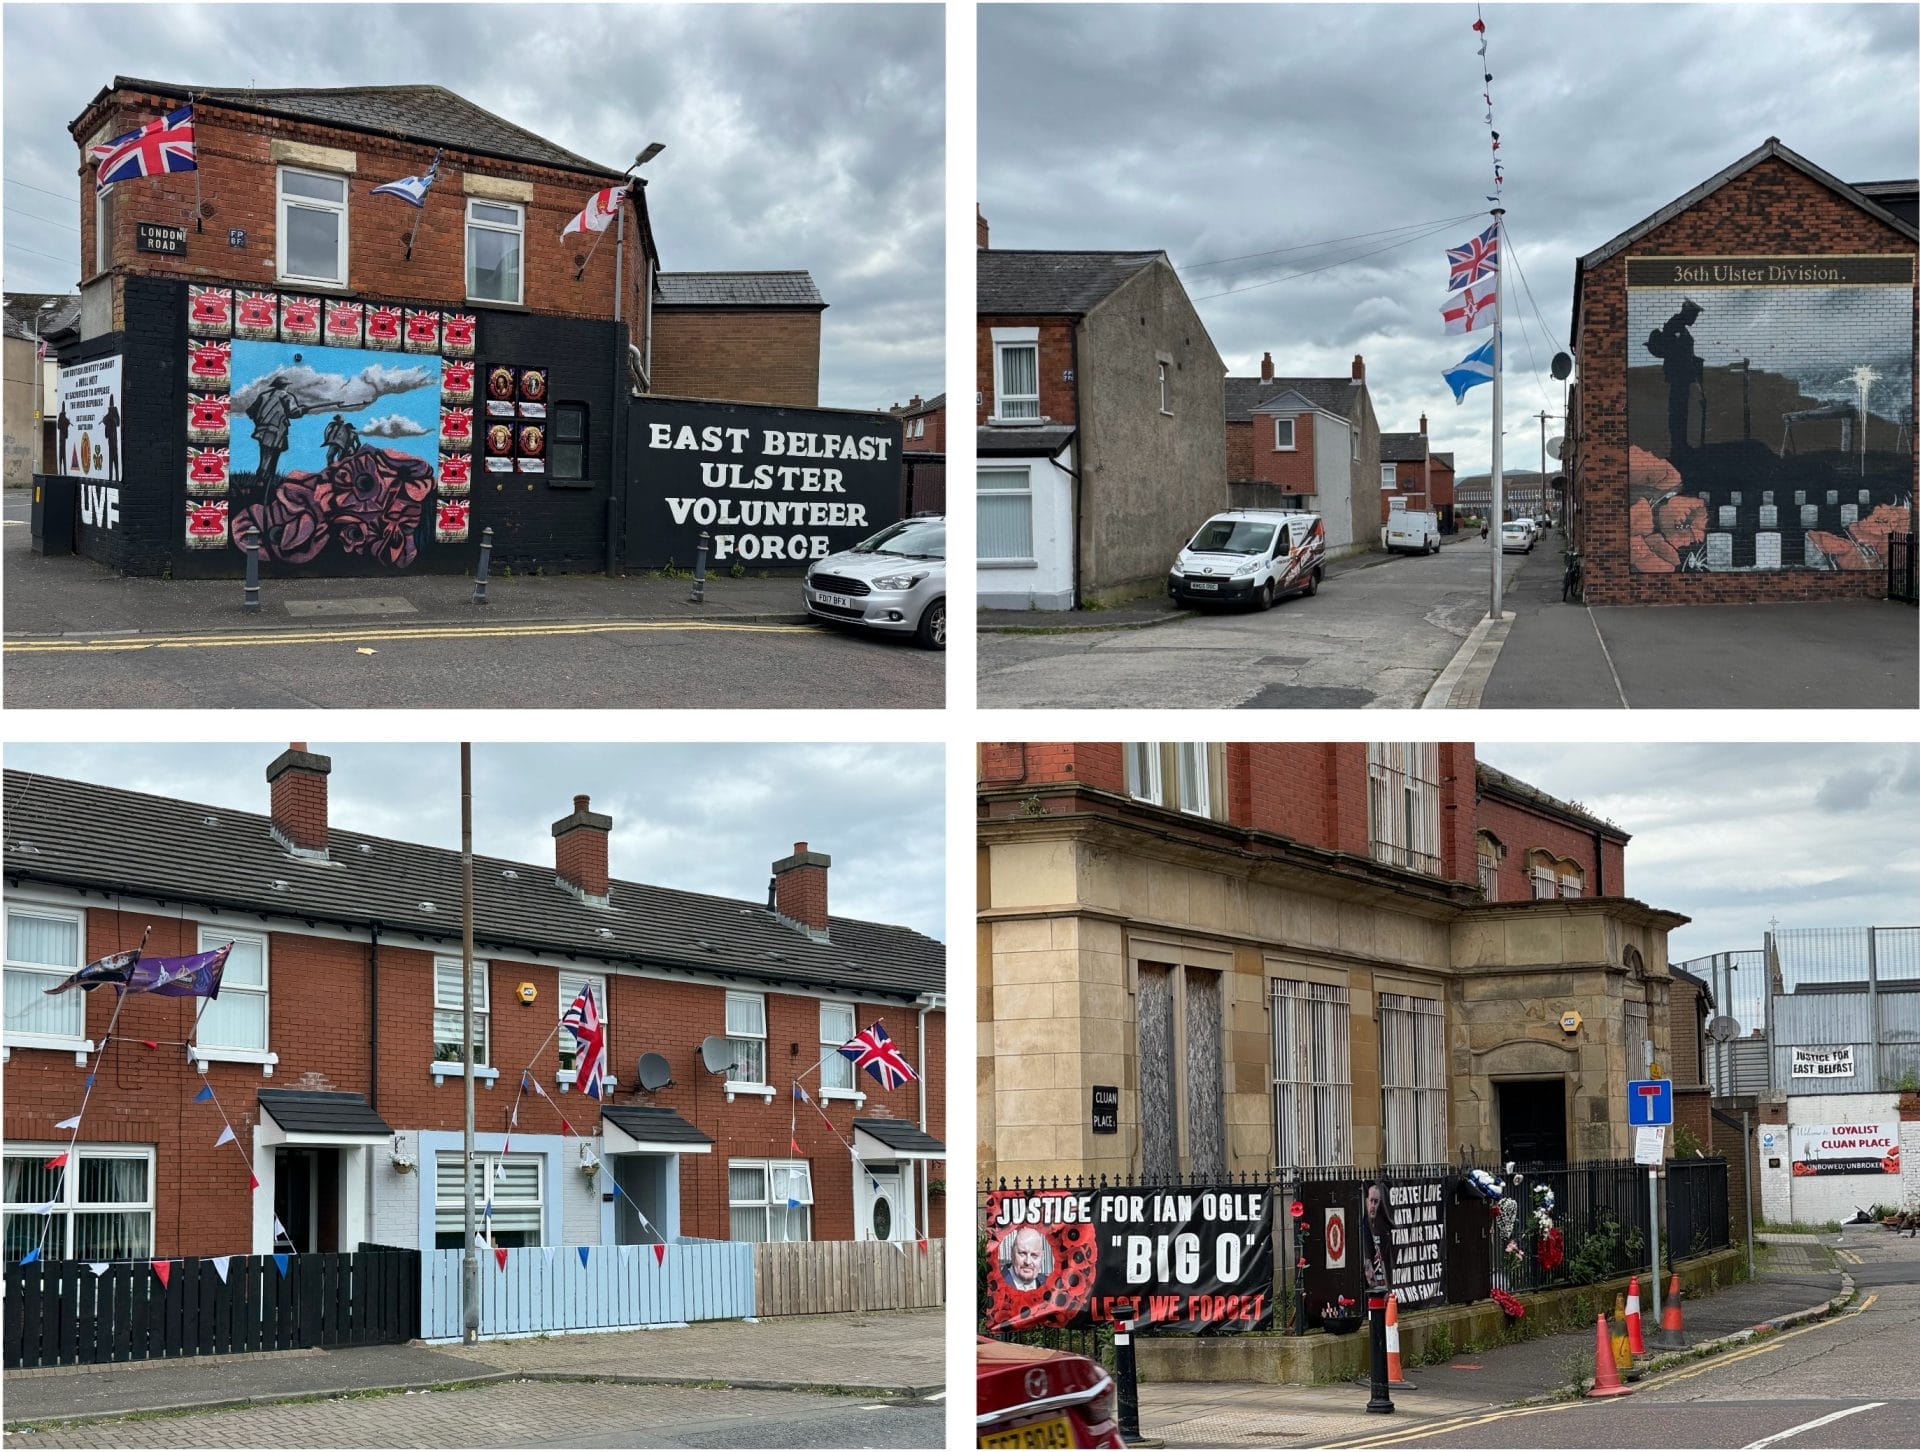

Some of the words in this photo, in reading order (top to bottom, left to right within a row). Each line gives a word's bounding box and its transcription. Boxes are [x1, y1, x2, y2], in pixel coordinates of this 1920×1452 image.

[141, 226, 183, 241] LONDON
[148, 239, 176, 251] ROAD
[1674, 266, 1709, 281] 36th
[1713, 266, 1764, 281] Ulster
[649, 423, 749, 453] EAST
[762, 430, 892, 461] BELFAST
[700, 462, 846, 493] ULSTER
[81, 483, 120, 530] UVF
[665, 497, 869, 527] VOLUNTEER
[714, 533, 830, 560] FORCE
[1796, 1051, 1830, 1062] JUSTICE
[1833, 1050, 1849, 1061] FOR
[1793, 1063, 1814, 1074] EAST
[1818, 1063, 1853, 1074] BELFAST
[1095, 1091, 1117, 1104] CLUAN
[1831, 1125, 1879, 1135] LOYALIST
[1821, 1140, 1856, 1149] CLUAN
[1859, 1138, 1891, 1148] PLACE
[1423, 1183, 1442, 1203] LOVE
[997, 1196, 1091, 1225] JUSTICE
[1101, 1195, 1144, 1223] FOR
[1154, 1195, 1192, 1223] IAN
[1202, 1193, 1262, 1222] OGLE
[1422, 1205, 1438, 1222] MAN
[1391, 1228, 1409, 1245] THAN
[1424, 1223, 1444, 1241] THAT
[1112, 1232, 1200, 1284] "BIG
[1396, 1248, 1403, 1265] A
[1419, 1243, 1438, 1261] LAYS
[1392, 1266, 1412, 1285] DOWN
[1413, 1264, 1425, 1281] HIS
[1405, 1285, 1420, 1302] HIS
[1149, 1295, 1180, 1322] WE
[1188, 1294, 1265, 1322] FORGET
